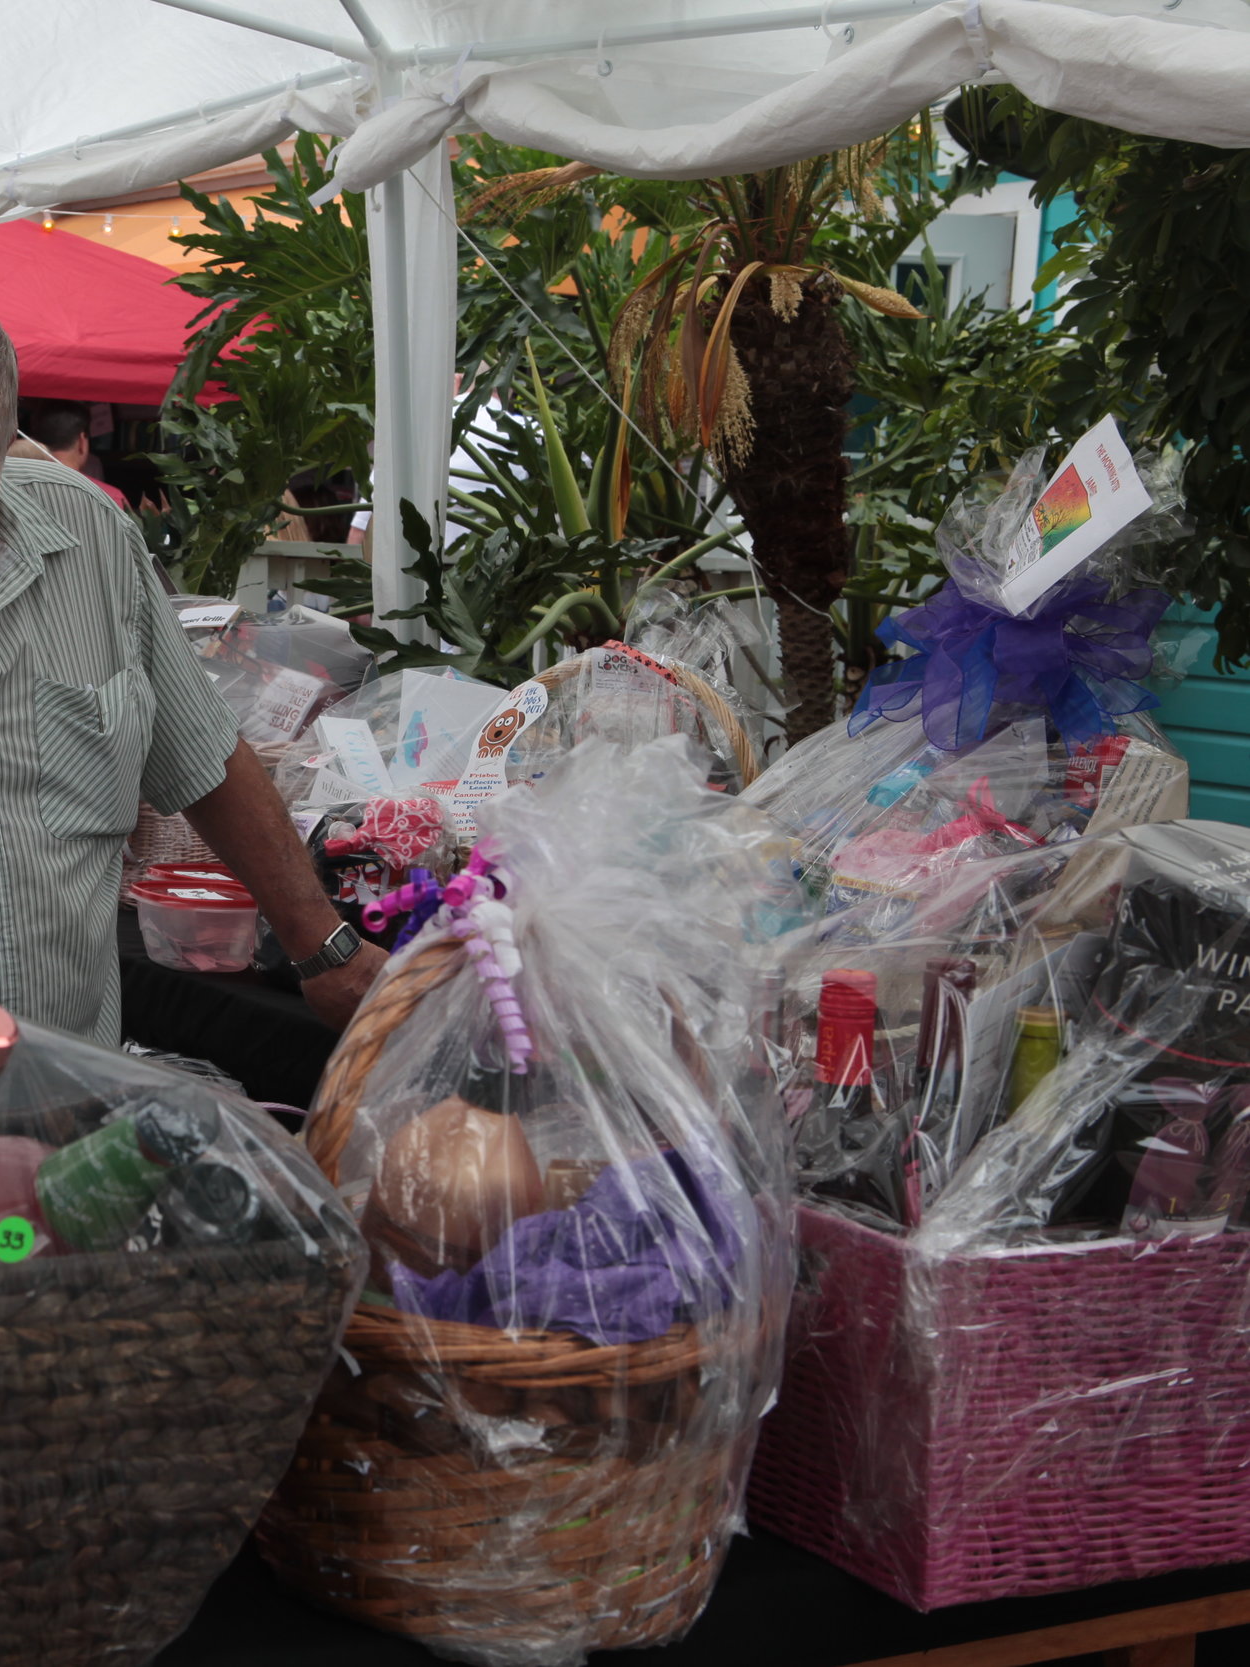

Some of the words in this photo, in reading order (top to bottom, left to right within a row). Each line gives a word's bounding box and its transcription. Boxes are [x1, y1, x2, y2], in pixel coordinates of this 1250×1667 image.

[604, 653, 627, 664] DOG
[525, 687, 539, 697] THE
[523, 695, 542, 705] DOGS
[525, 704, 545, 714] OUT?
[269, 715, 294, 733] SLAB
[321, 780, 343, 800] what
[1170, 1197, 1177, 1214] 1
[1215, 1193, 1230, 1212] 2
